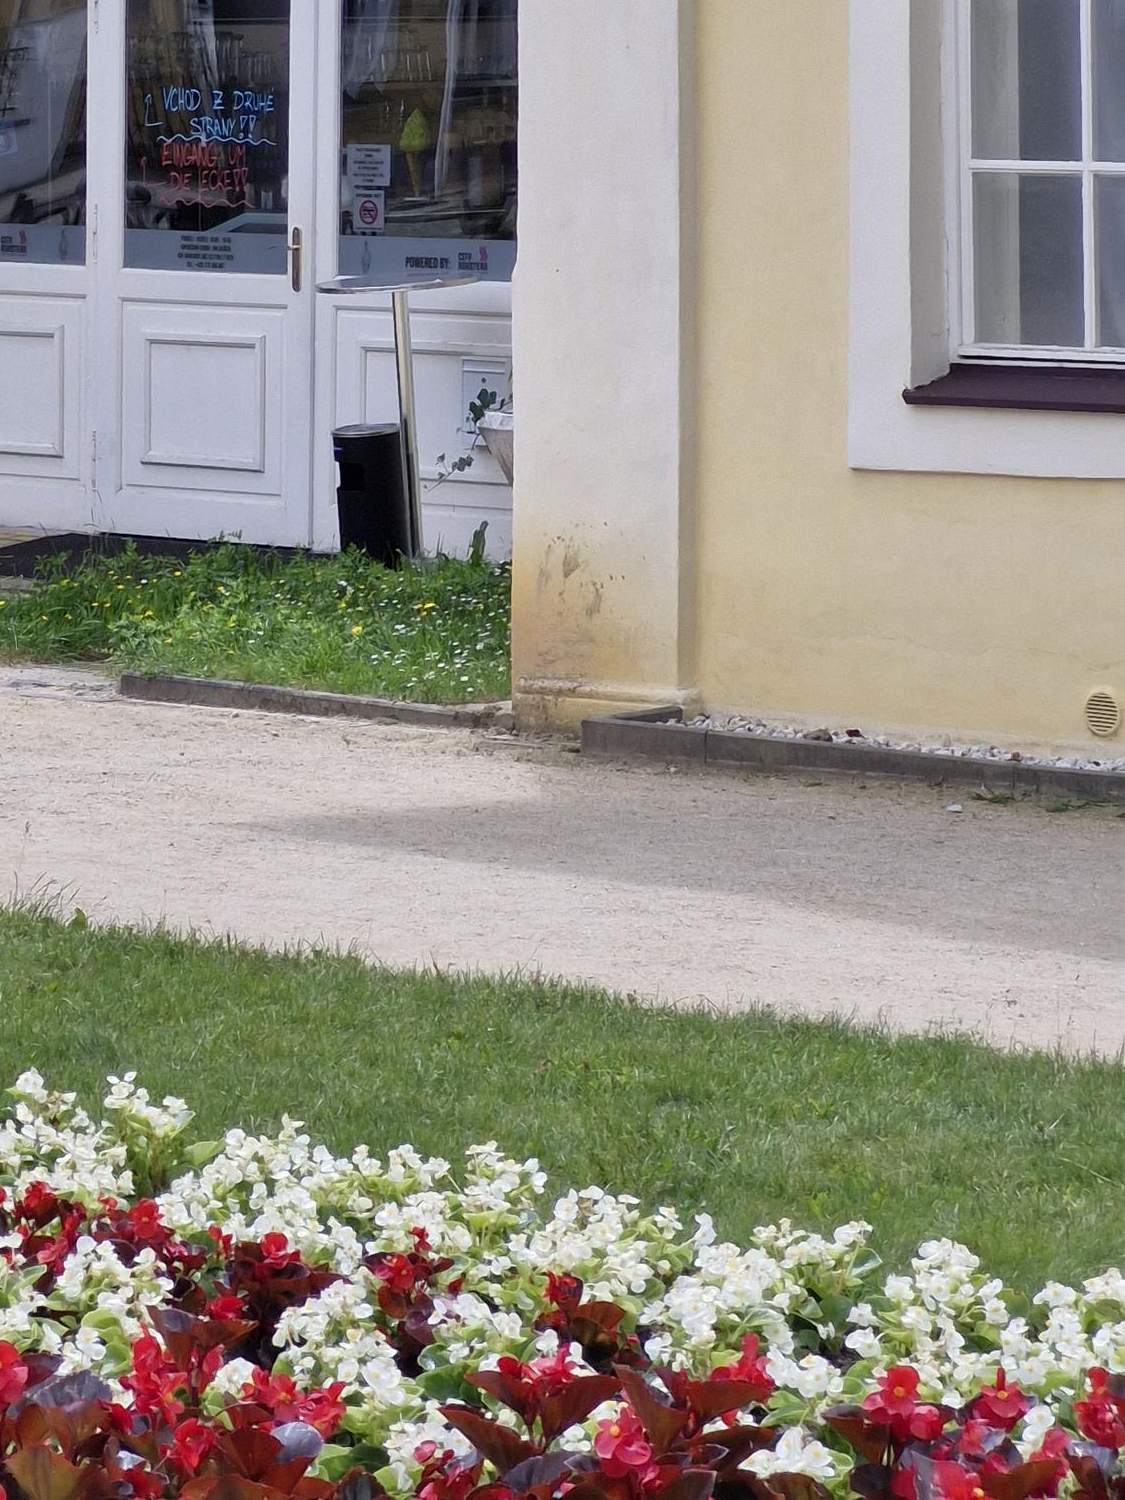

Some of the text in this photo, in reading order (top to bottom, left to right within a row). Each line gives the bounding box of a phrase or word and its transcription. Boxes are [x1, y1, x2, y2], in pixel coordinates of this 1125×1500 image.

[163, 86, 201, 111] VCHOD
[213, 91, 224, 109] Z
[229, 145, 246, 165] UM
[405, 257, 438, 269] POWERED
